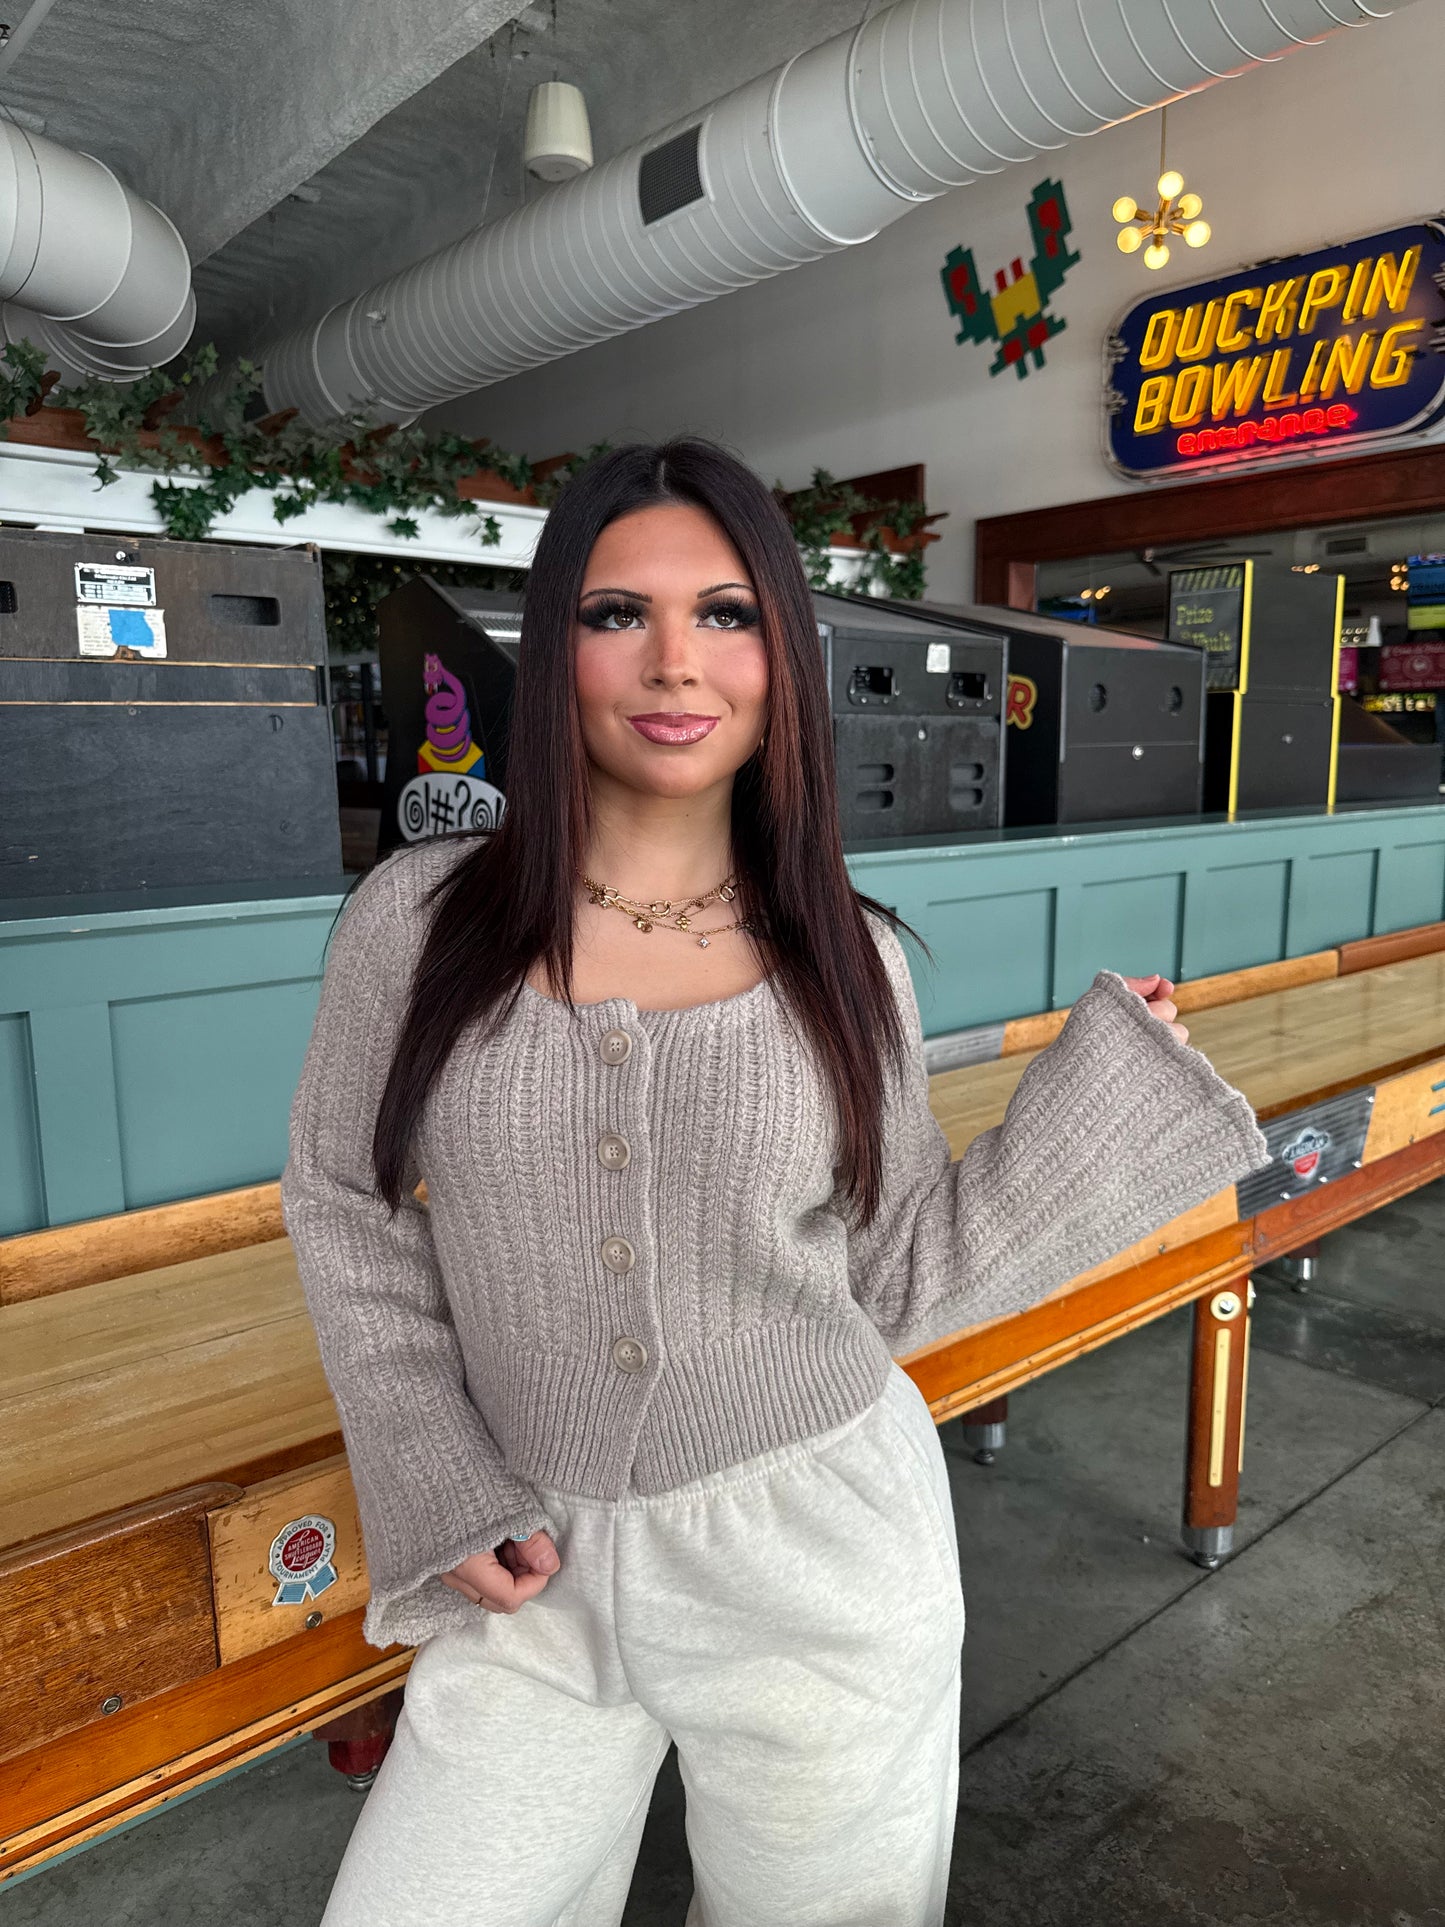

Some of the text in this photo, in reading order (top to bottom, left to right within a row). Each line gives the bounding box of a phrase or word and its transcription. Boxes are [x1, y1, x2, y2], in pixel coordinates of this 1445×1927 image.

[1139, 244, 1422, 372] DUCKPIN
[1134, 318, 1425, 436] BOWLING
[1177, 403, 1354, 455] entrance
[277, 1520, 329, 1551] APPROVED FOR
[288, 1535, 320, 1552] AMERICAN
[275, 1543, 332, 1580] TOURNAMENT PLAY
